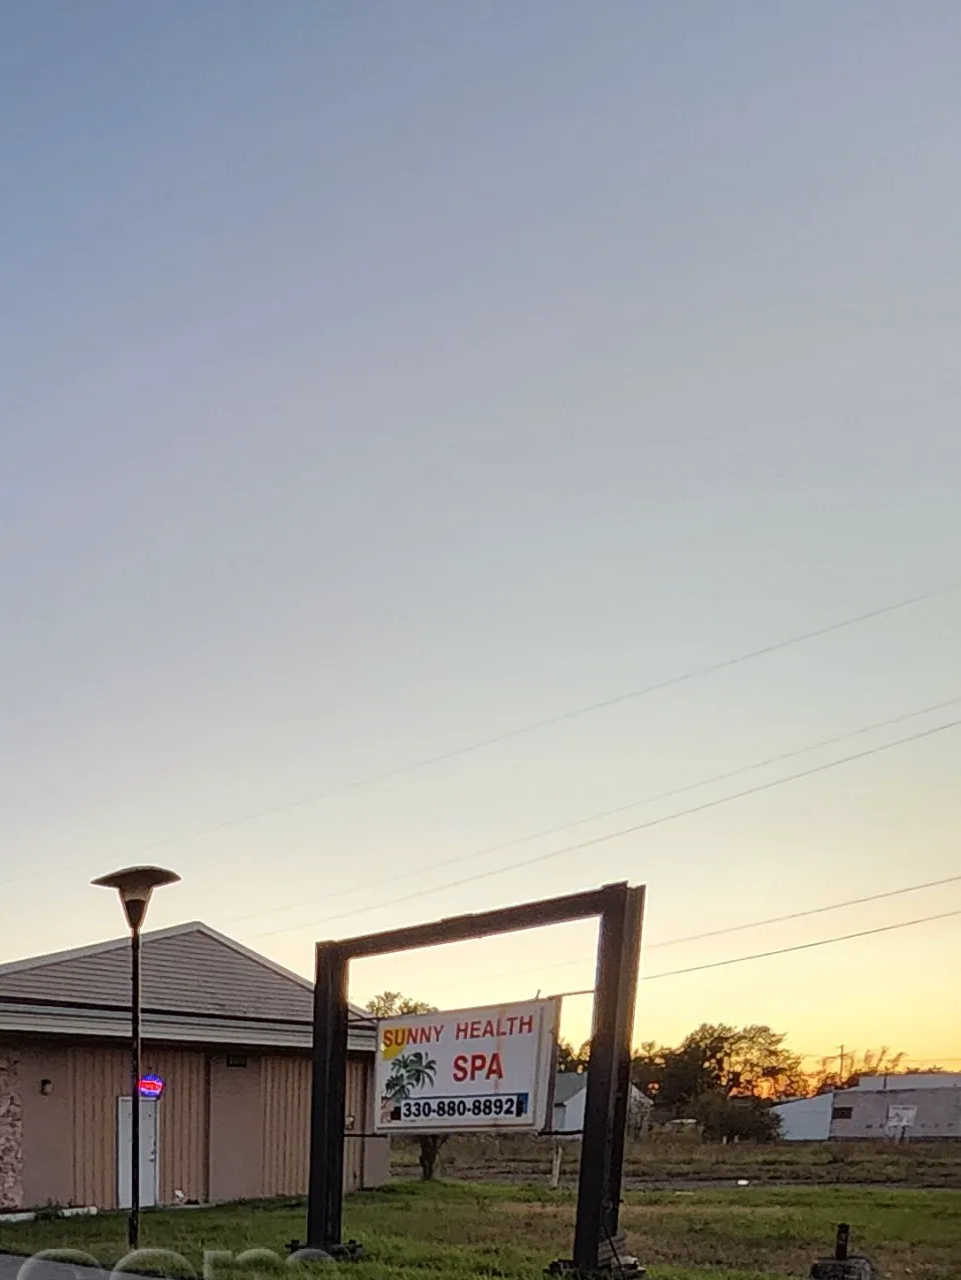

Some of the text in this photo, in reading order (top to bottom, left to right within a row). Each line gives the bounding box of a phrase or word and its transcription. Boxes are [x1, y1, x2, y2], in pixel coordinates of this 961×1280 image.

[383, 1015, 534, 1047] SUNNY HEALTH
[453, 1052, 503, 1082] SPA
[403, 1098, 515, 1118] 330-880-8892
